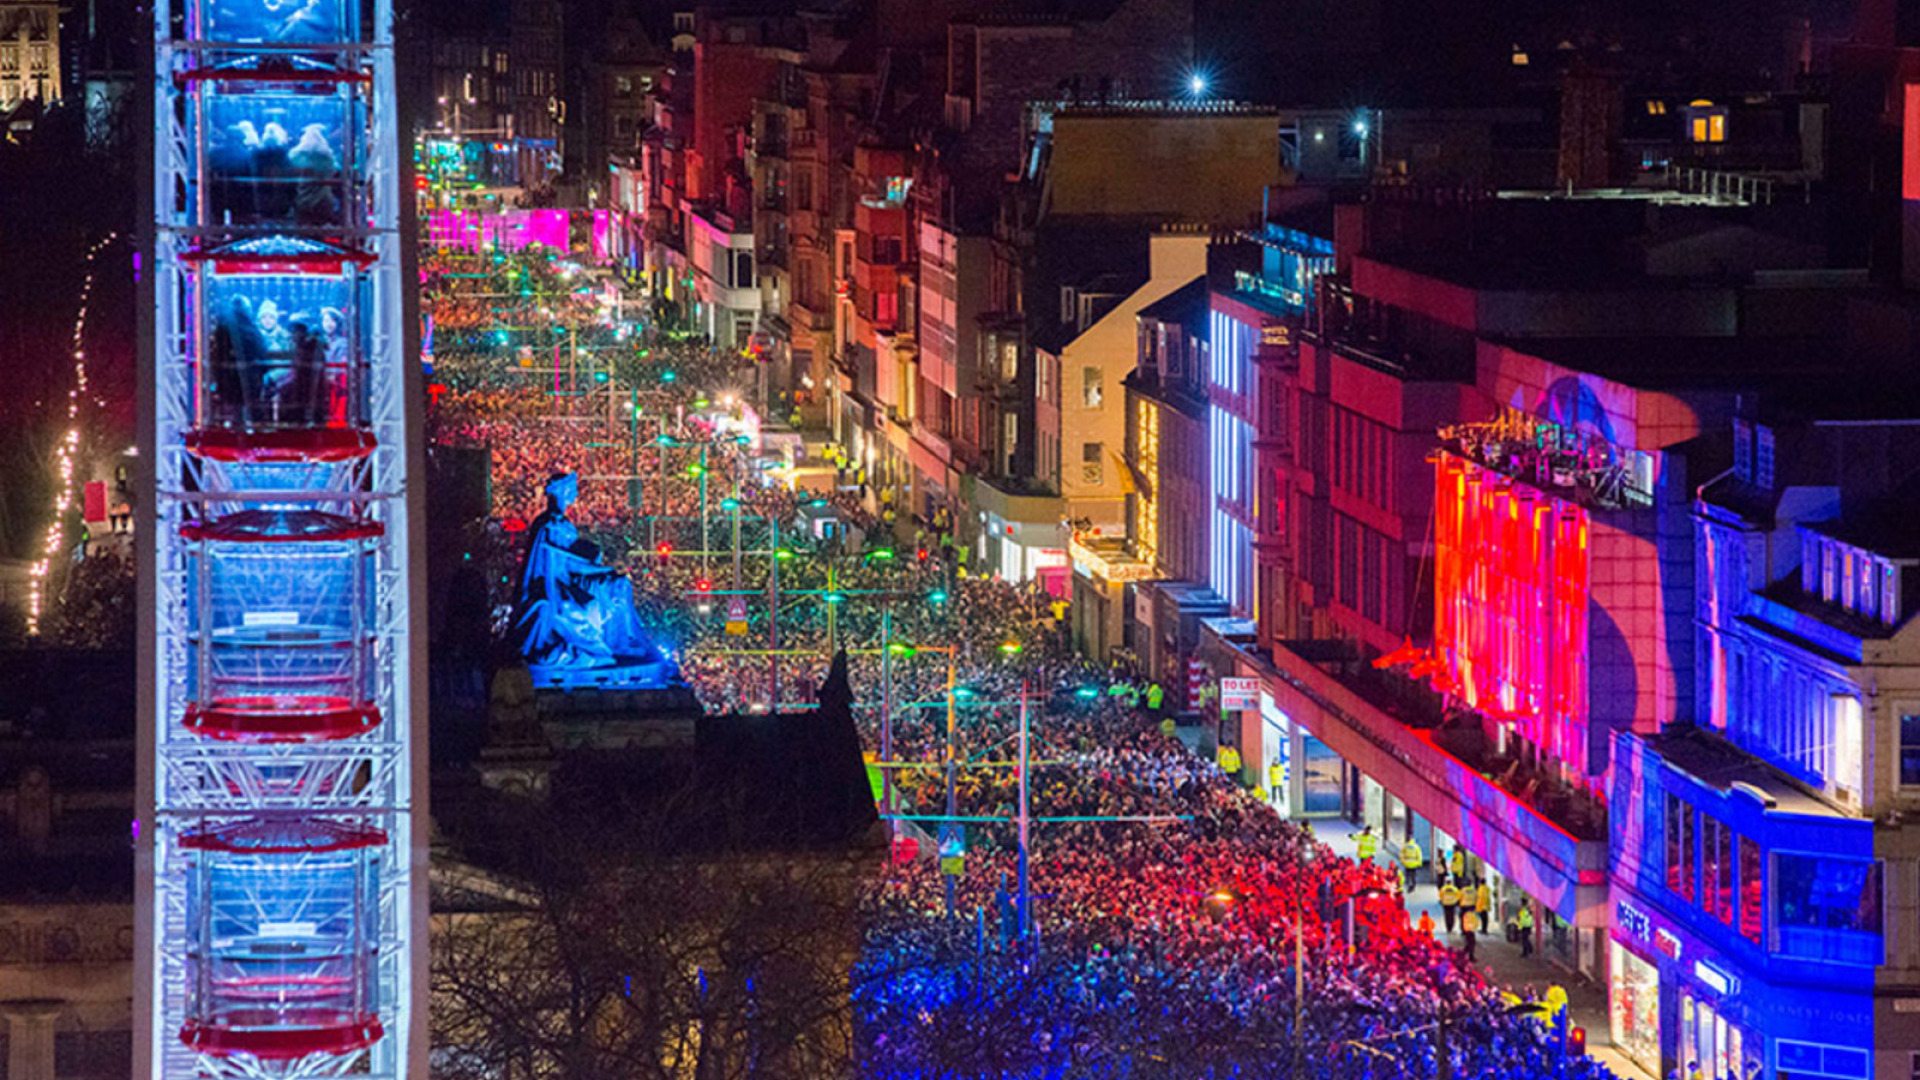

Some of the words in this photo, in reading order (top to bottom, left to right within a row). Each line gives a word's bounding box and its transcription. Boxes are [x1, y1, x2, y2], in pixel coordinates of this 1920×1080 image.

[1223, 679, 1237, 690] TO
[1239, 679, 1260, 690] LET
[1769, 1003, 1820, 1020] ERNEST
[1829, 1010, 1871, 1026] JONES
